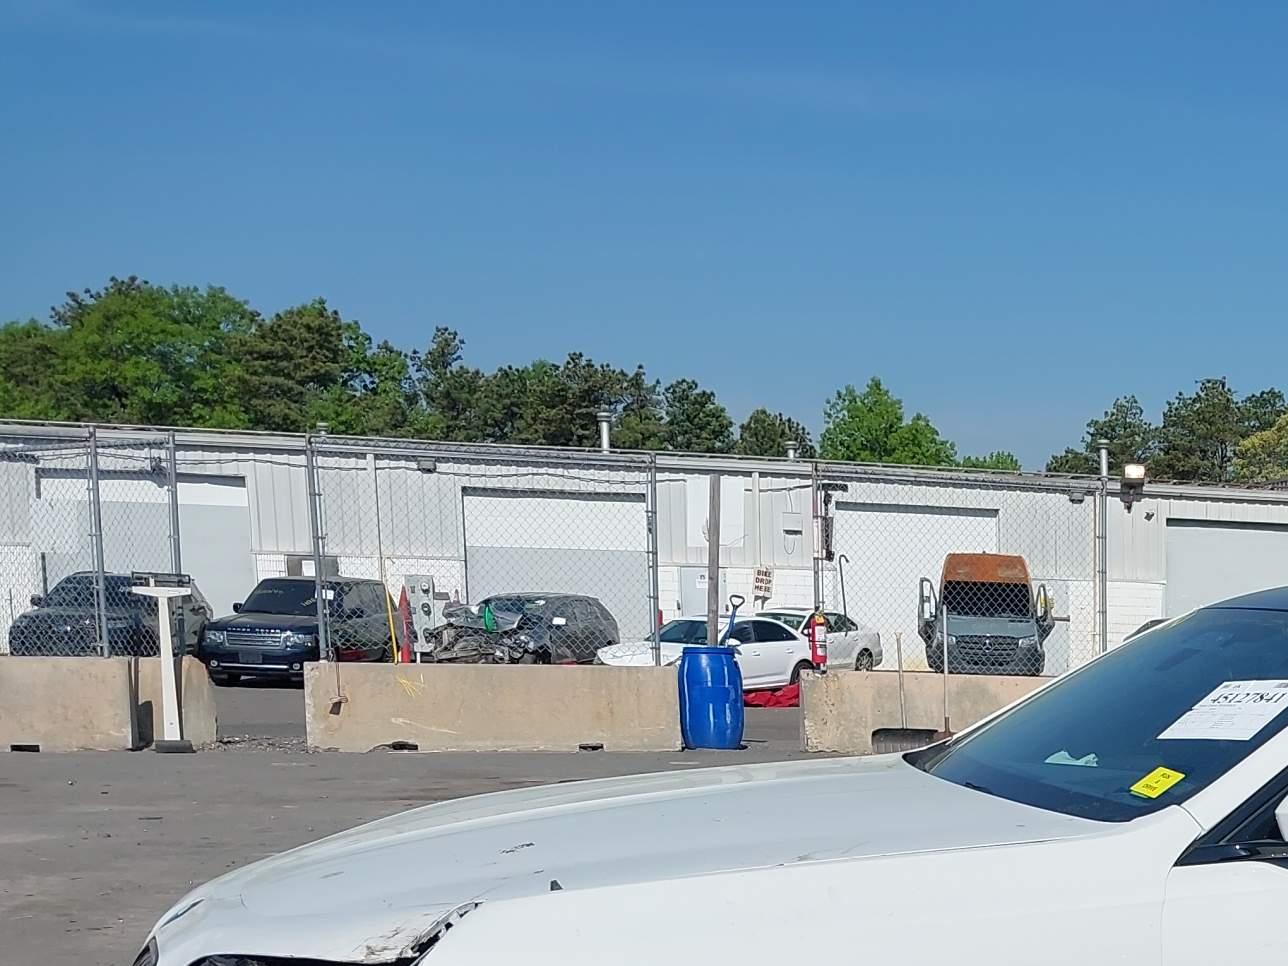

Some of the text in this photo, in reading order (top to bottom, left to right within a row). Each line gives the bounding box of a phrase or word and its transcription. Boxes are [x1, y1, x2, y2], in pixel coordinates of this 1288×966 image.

[757, 569, 772, 578] BIKE
[755, 577, 772, 585] DROP
[754, 584, 771, 593] HERE
[1210, 692, 1288, 704] 45127841
